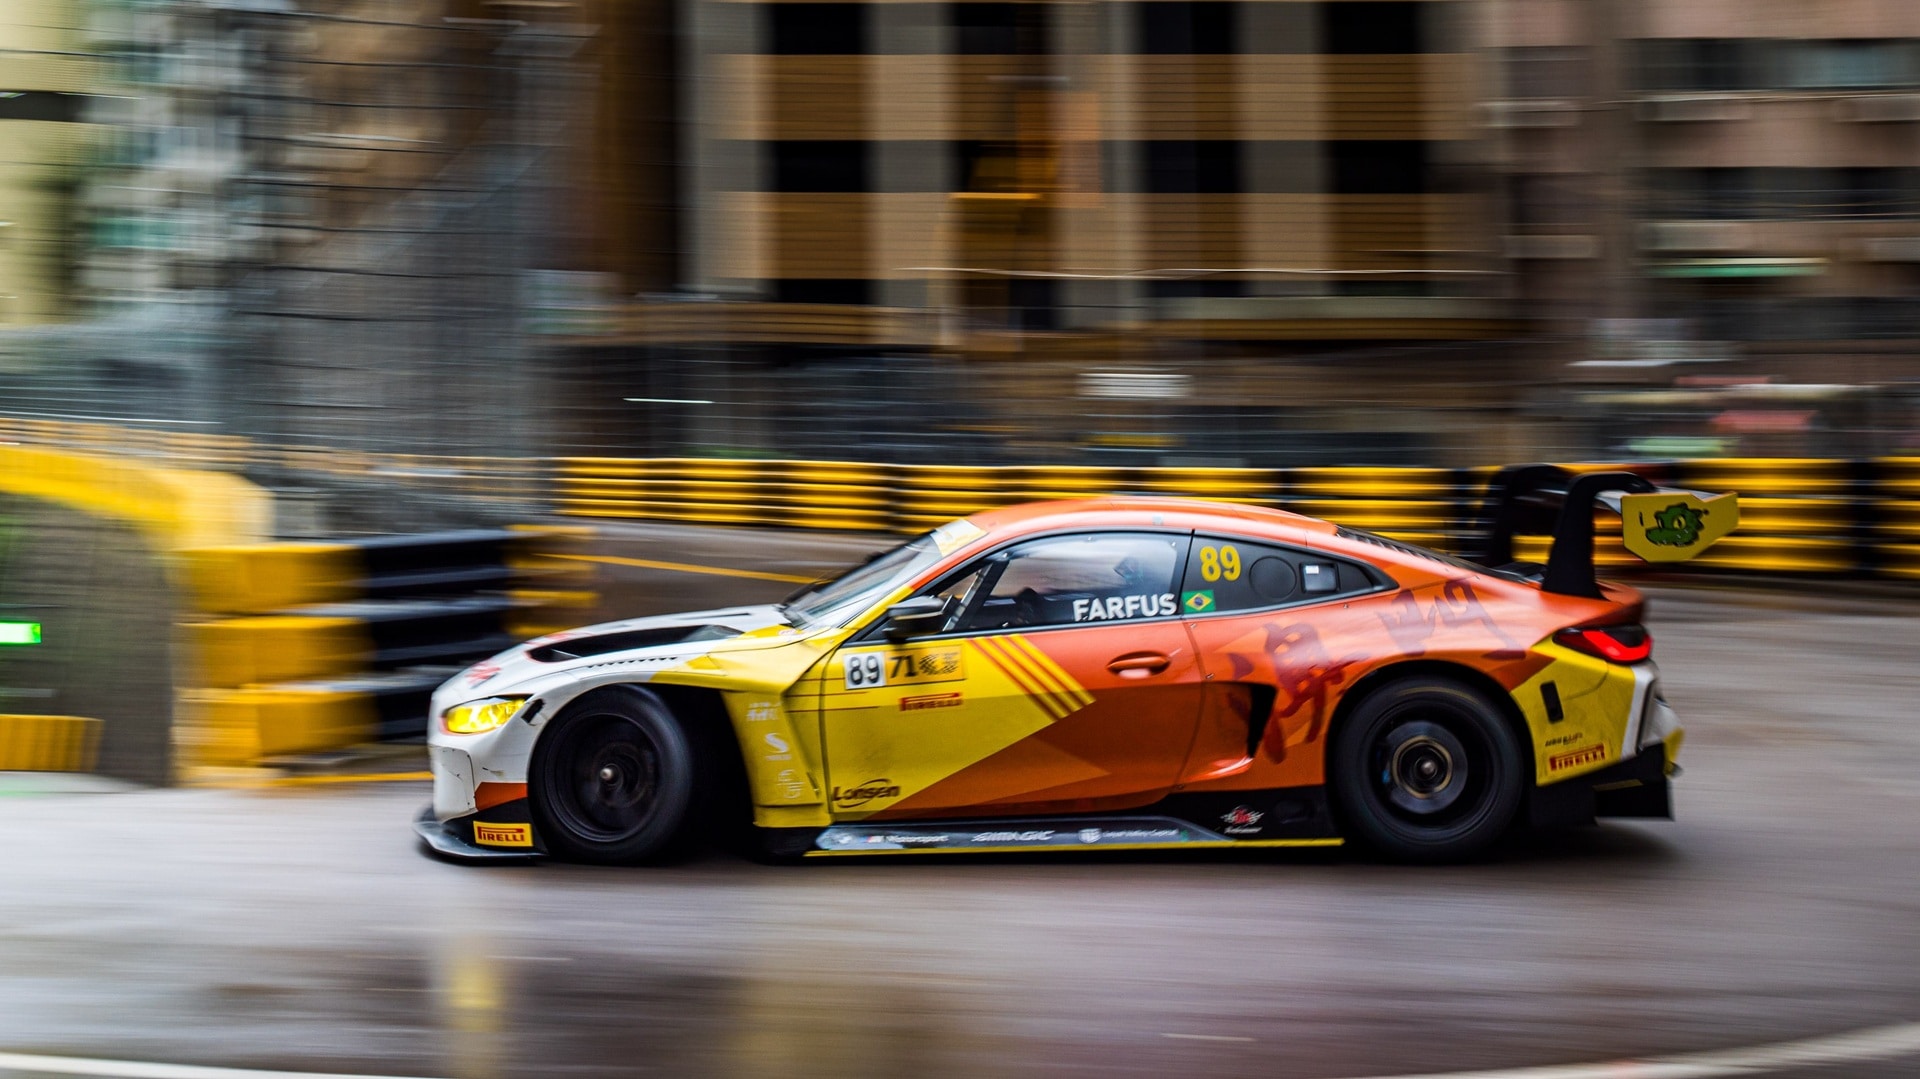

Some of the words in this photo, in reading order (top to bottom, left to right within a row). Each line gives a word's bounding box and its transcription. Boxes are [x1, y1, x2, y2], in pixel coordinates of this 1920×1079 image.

[1200, 545, 1241, 582] 89
[1073, 593, 1177, 622] FARFUS
[848, 655, 881, 686] 89
[890, 654, 918, 679] 71
[1549, 743, 1605, 771] PIRELLI
[832, 785, 900, 802] Lonsen
[477, 826, 525, 842] PIRELLI
